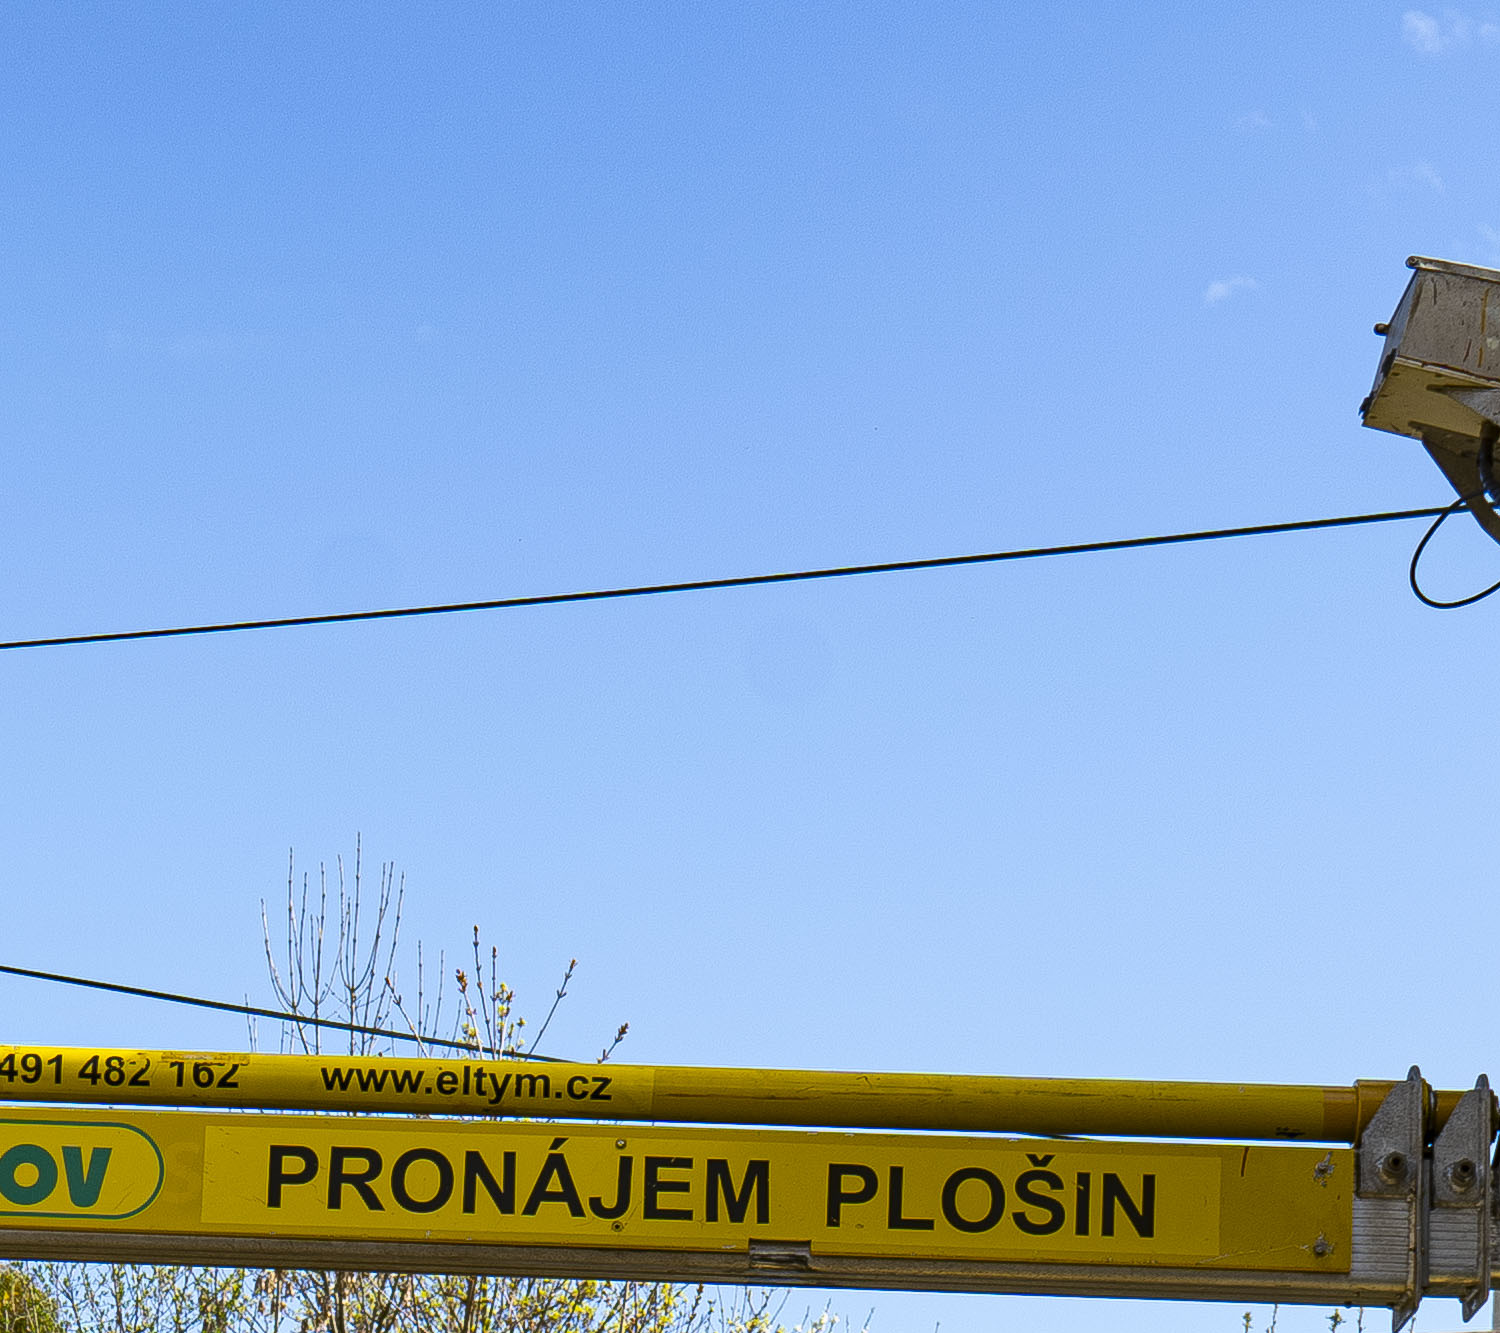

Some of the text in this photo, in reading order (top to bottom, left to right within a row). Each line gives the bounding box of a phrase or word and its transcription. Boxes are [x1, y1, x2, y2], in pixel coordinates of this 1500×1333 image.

[77, 1055, 151, 1088] 482
[169, 1060, 240, 1089] 162
[320, 1065, 613, 1104] www.eltym.cz
[267, 1137, 1156, 1239] PRONÁJEM PLOŠIN
